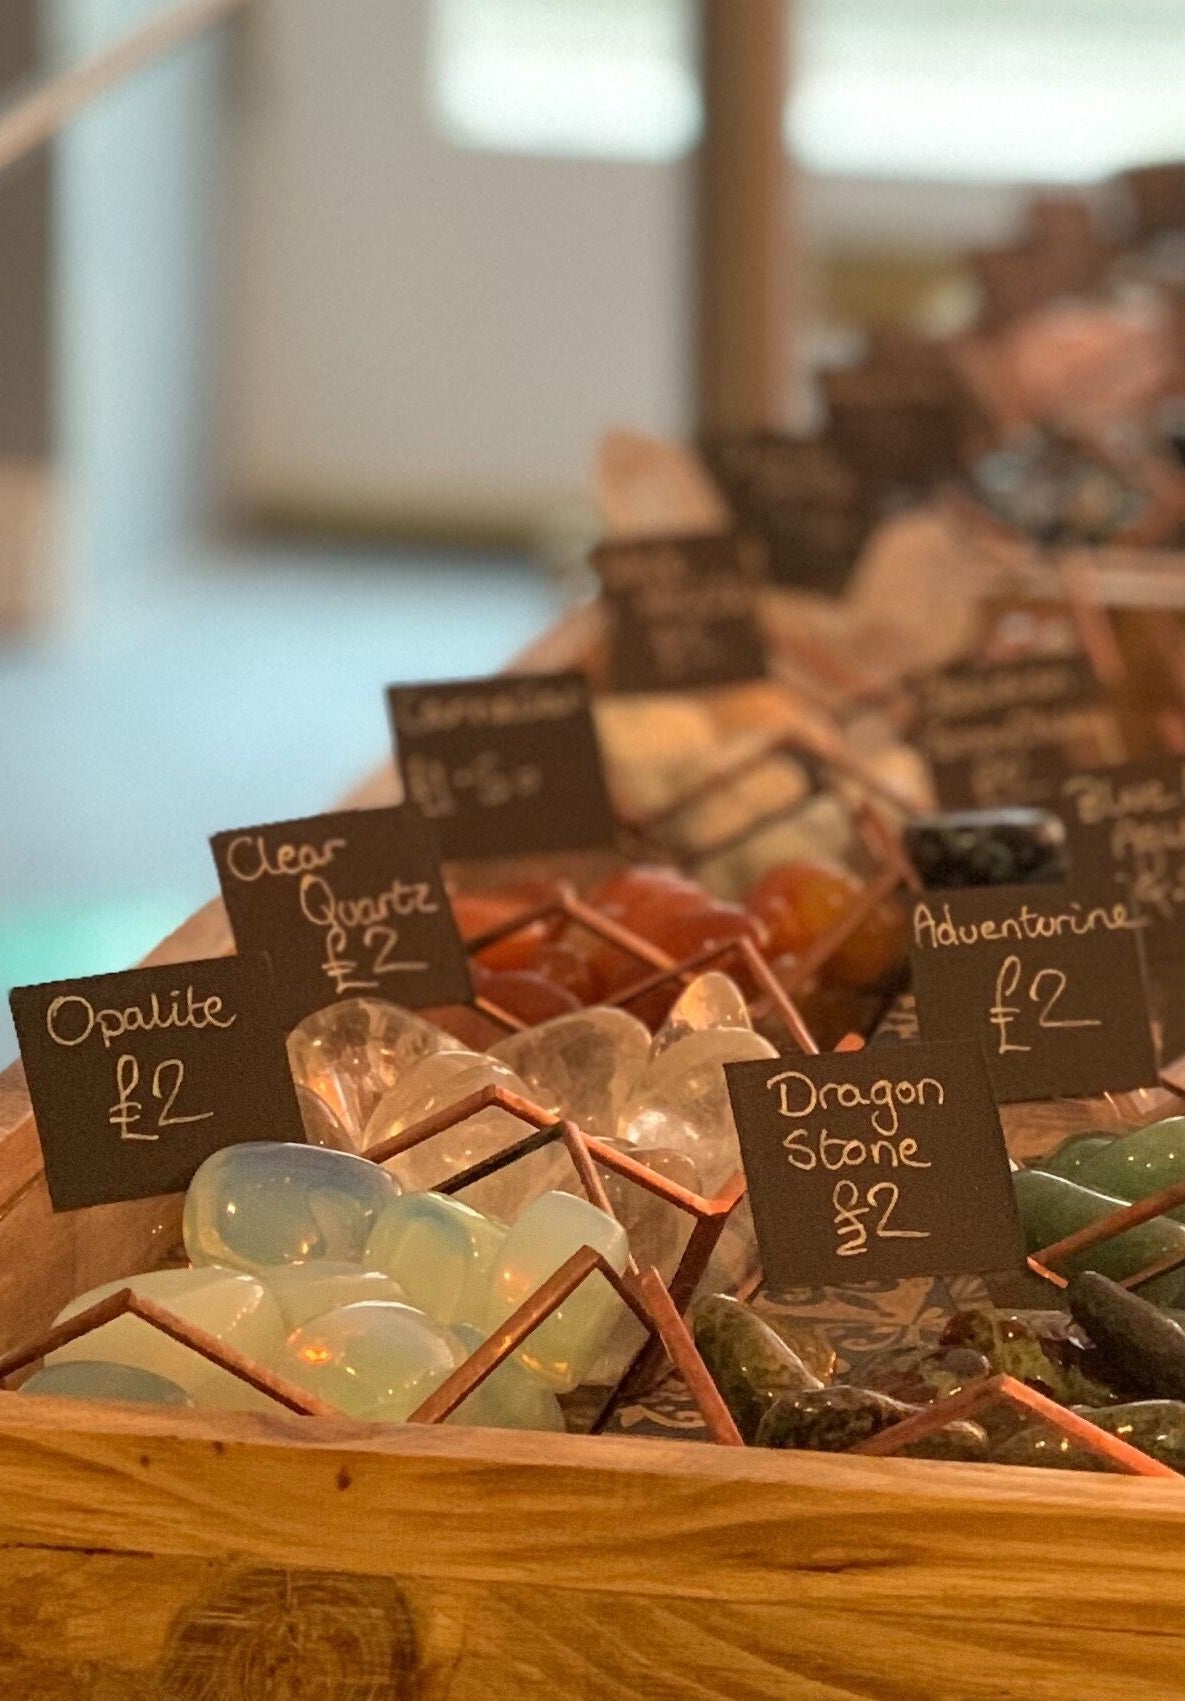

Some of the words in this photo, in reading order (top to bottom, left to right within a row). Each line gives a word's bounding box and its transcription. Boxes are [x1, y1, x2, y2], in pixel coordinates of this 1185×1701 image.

[226, 836, 347, 882] Clear
[300, 875, 440, 928] Quartz
[913, 901, 1151, 950] Adventurine
[321, 926, 429, 994] £2
[46, 985, 237, 1047] Opalite
[988, 955, 1103, 1055] £2
[108, 1054, 214, 1141] £2
[766, 1070, 945, 1136] Dragon
[781, 1128, 932, 1170] Stone
[831, 1179, 930, 1257] £2
